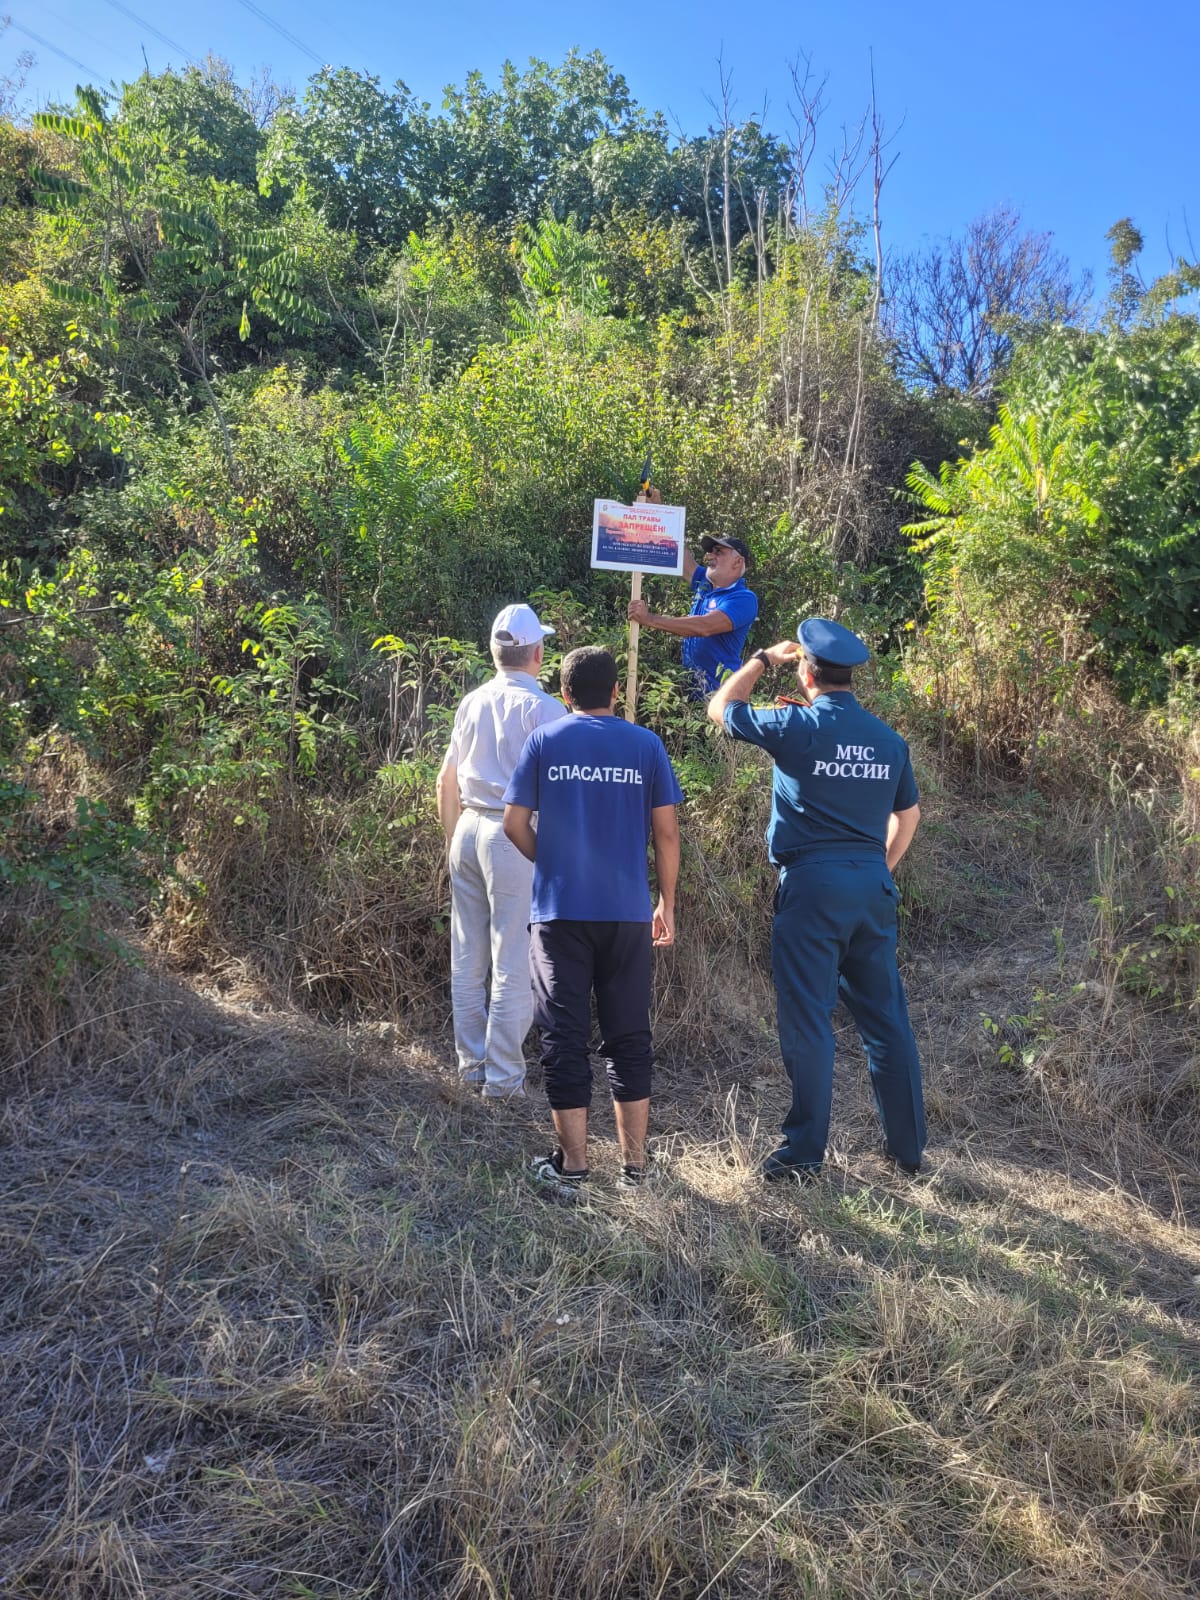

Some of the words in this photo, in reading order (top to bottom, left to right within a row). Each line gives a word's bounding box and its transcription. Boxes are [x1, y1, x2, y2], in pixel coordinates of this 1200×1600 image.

[835, 744, 875, 761] МЧС
[547, 764, 643, 785] СПАСАТЕЛЬ
[812, 760, 890, 780] РОССИИ
